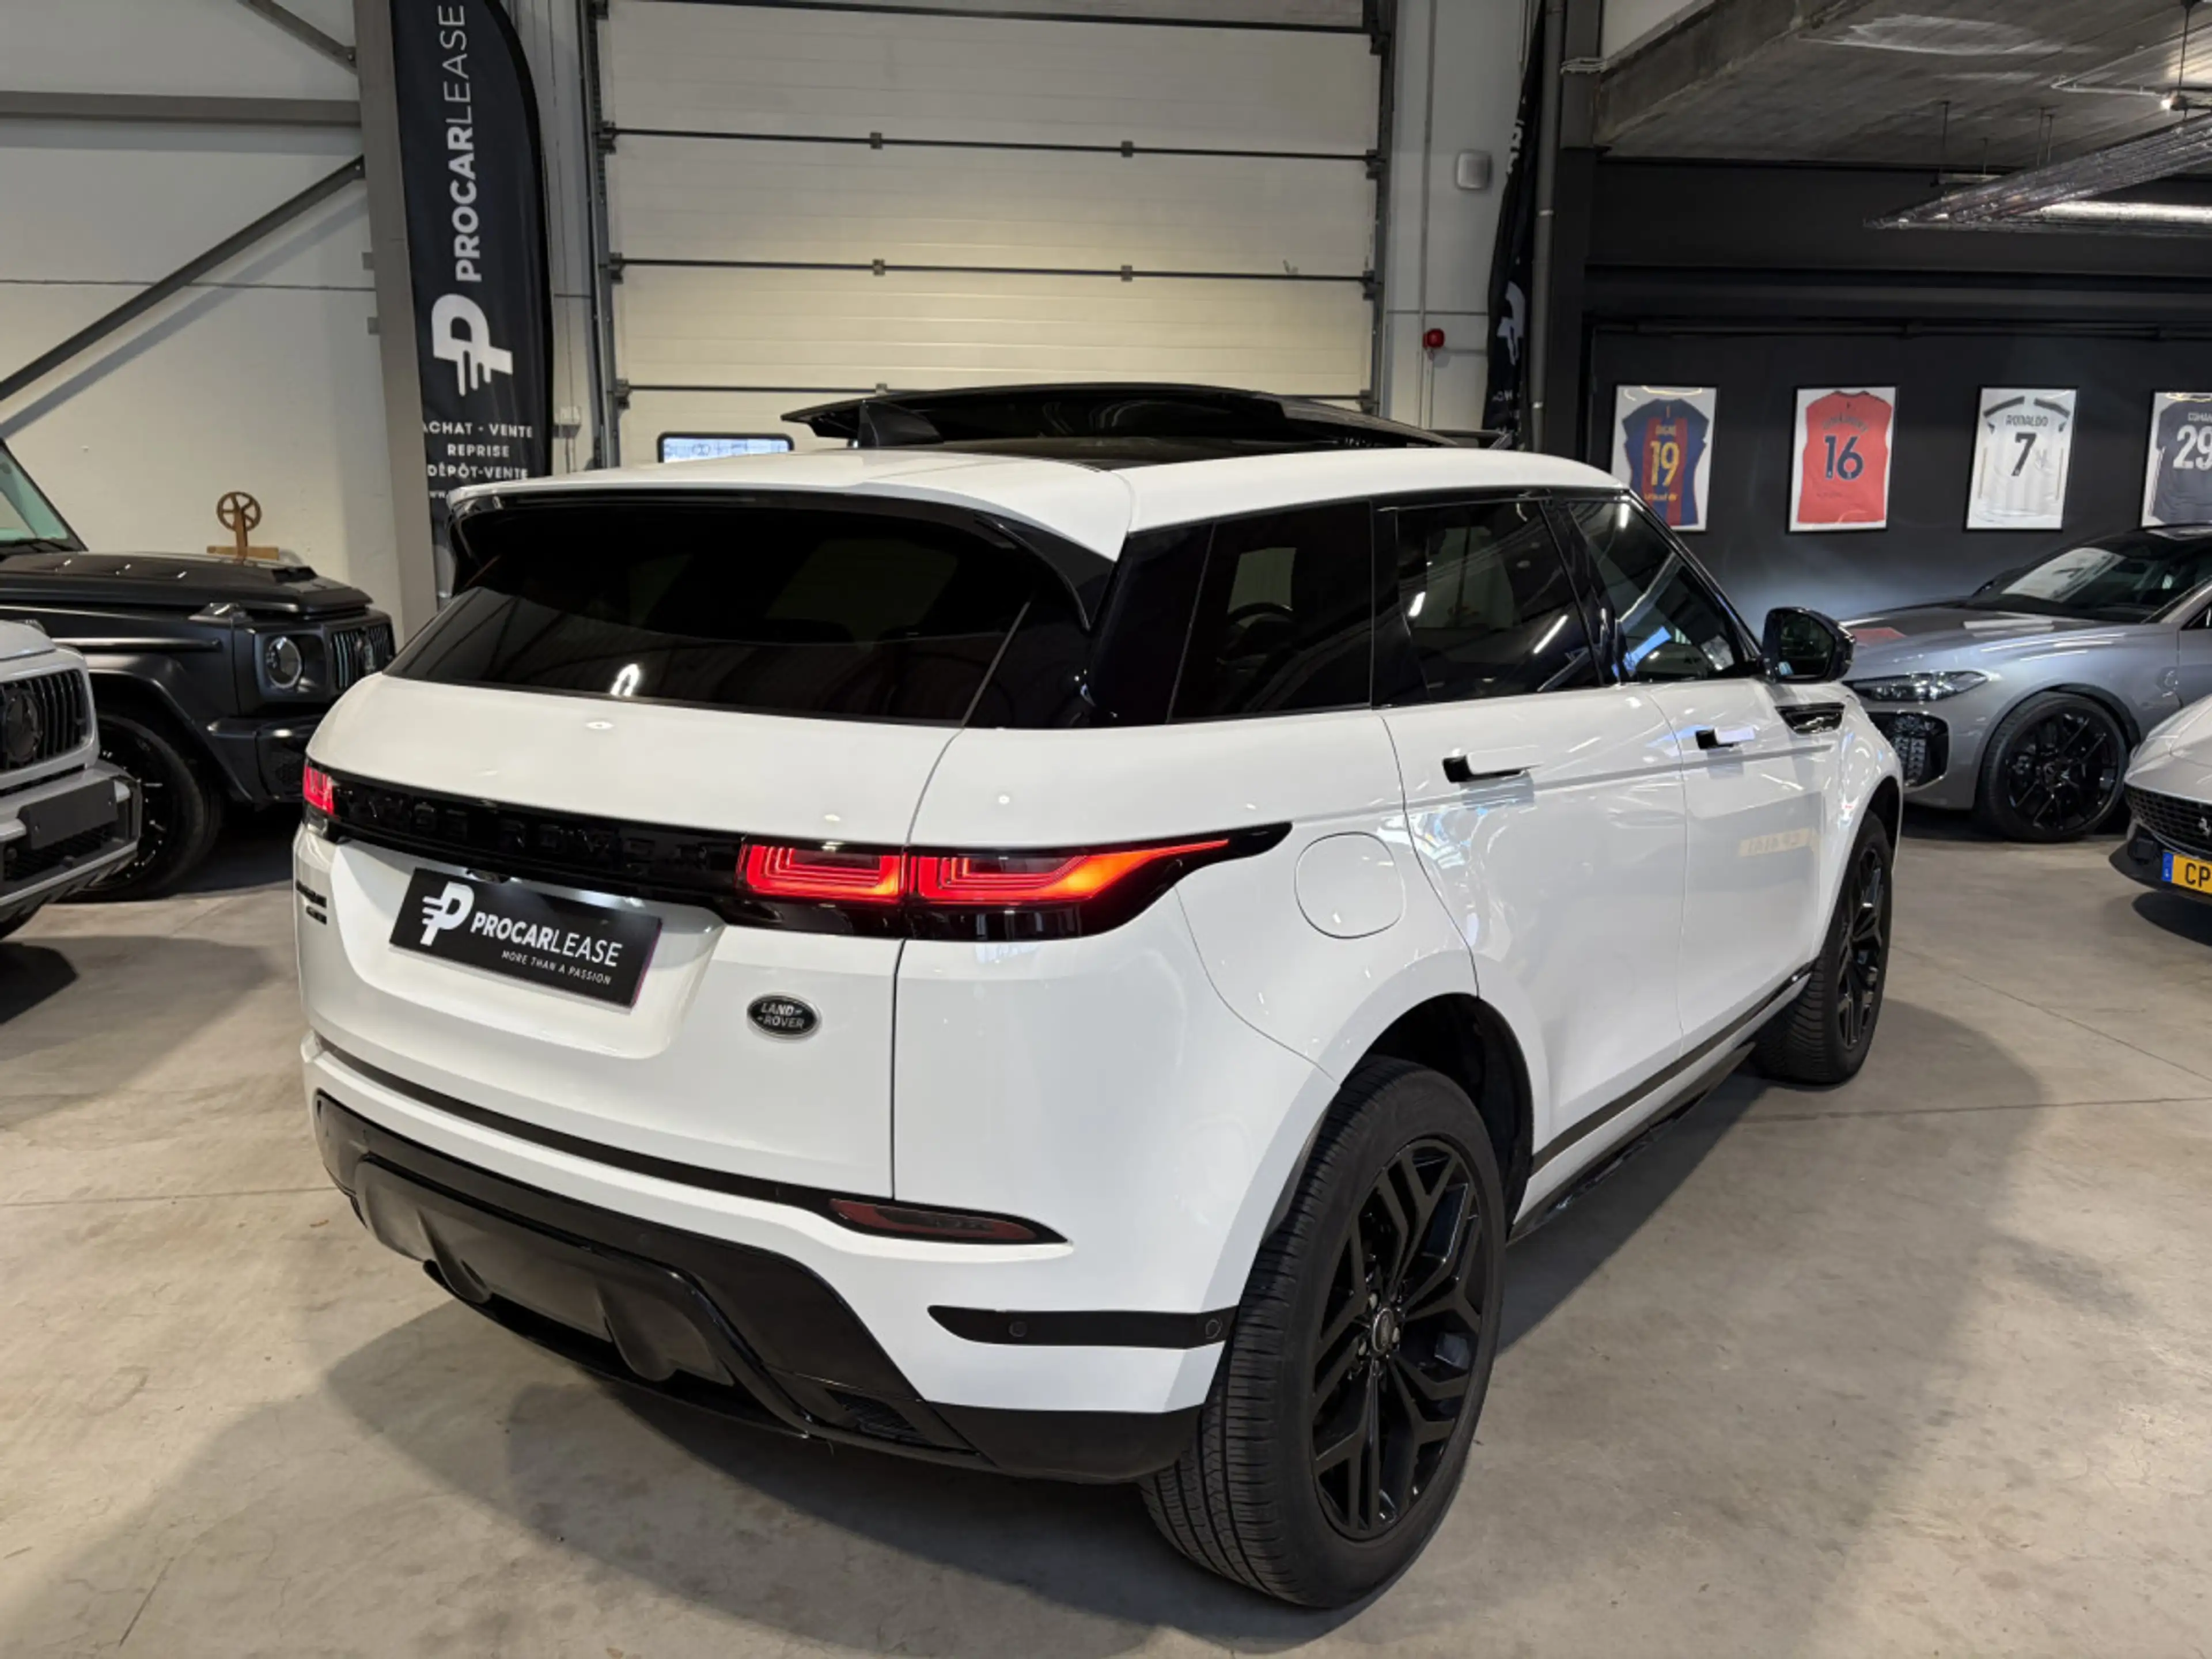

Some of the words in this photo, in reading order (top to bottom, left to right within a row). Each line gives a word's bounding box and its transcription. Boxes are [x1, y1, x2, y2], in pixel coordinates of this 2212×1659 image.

[438, 5, 482, 282] PROCARLEASE
[489, 423, 533, 438] VENTE
[2005, 414, 2048, 427] RONALDO
[447, 443, 510, 457] REPRISE
[1650, 440, 1680, 486] 19
[1824, 435, 1864, 480] 16
[2011, 432, 2037, 477] 7
[2172, 425, 2212, 470] 29
[470, 912, 623, 967] PROCARLEASE
[501, 950, 528, 965] MORE
[531, 956, 556, 971] THAN
[558, 964, 566, 974] A
[567, 965, 612, 985] PASSION
[761, 1002, 795, 1016] LAND
[763, 1014, 805, 1029] ROVER
